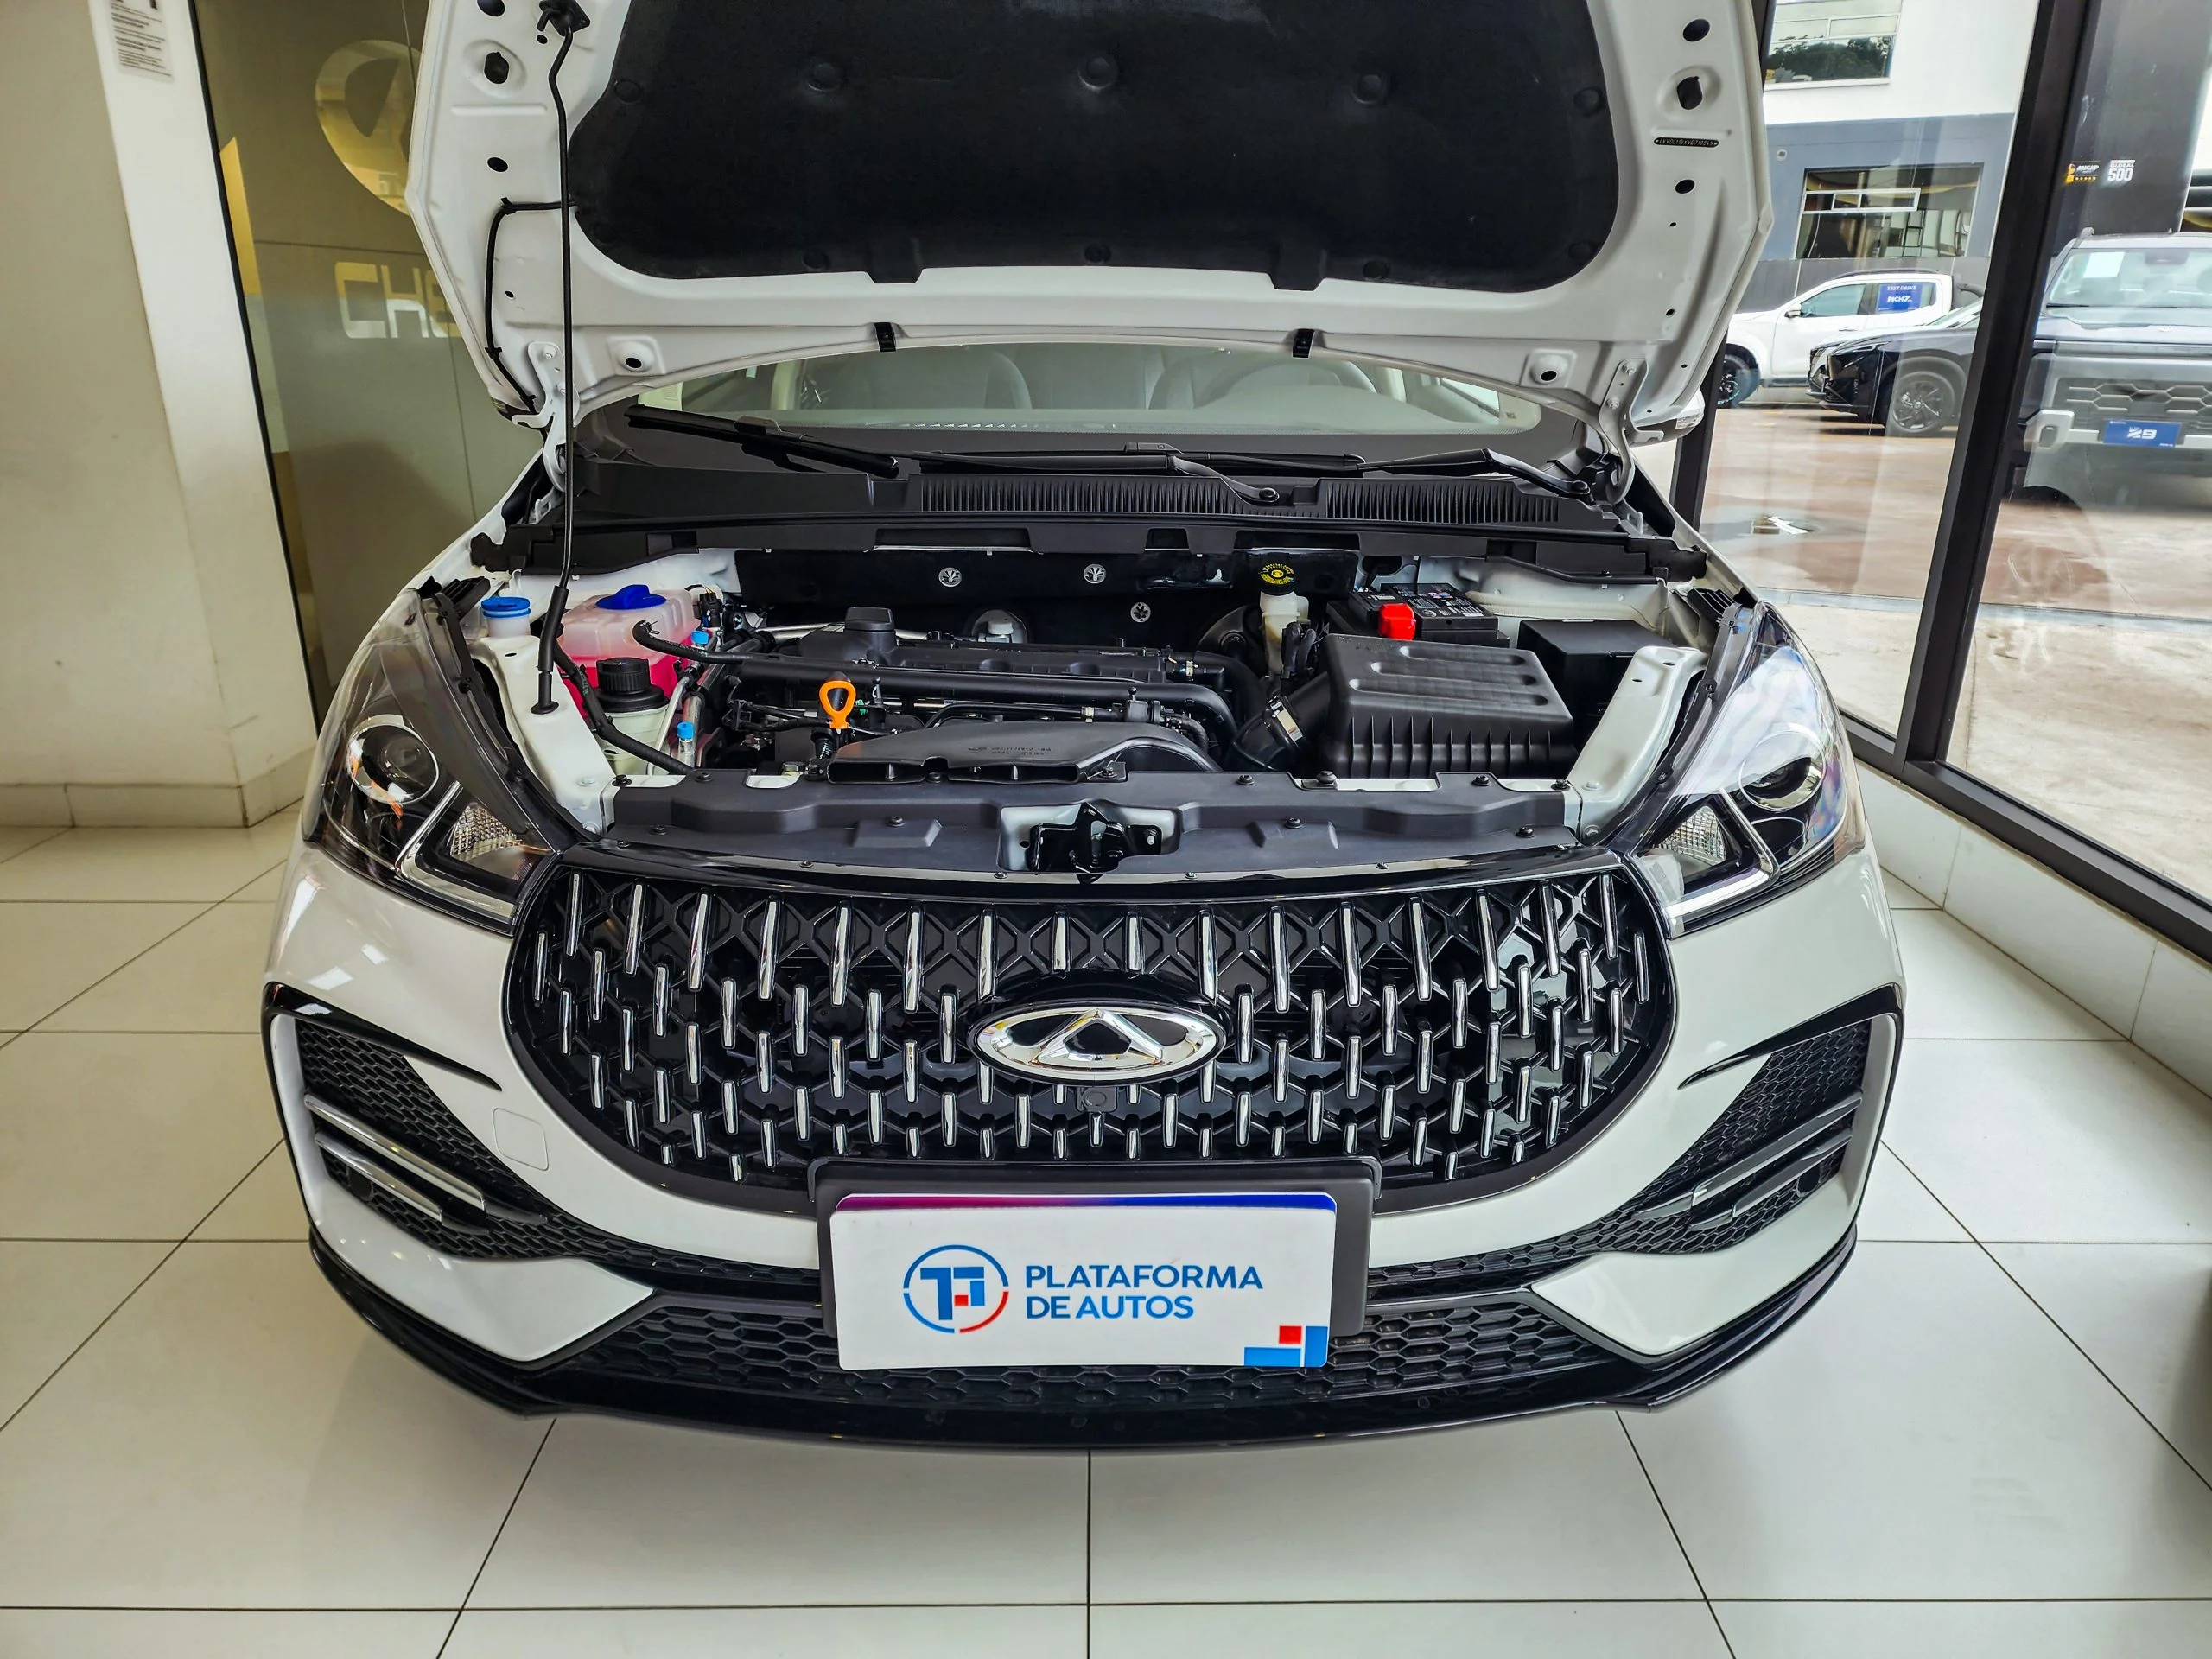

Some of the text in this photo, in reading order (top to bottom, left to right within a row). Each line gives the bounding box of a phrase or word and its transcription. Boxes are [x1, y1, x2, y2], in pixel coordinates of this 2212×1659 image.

[2108, 168, 2133, 181] 500
[1025, 1264, 1264, 1290] PLATAFORMA
[1025, 1294, 1197, 1320] DE AUTOS
